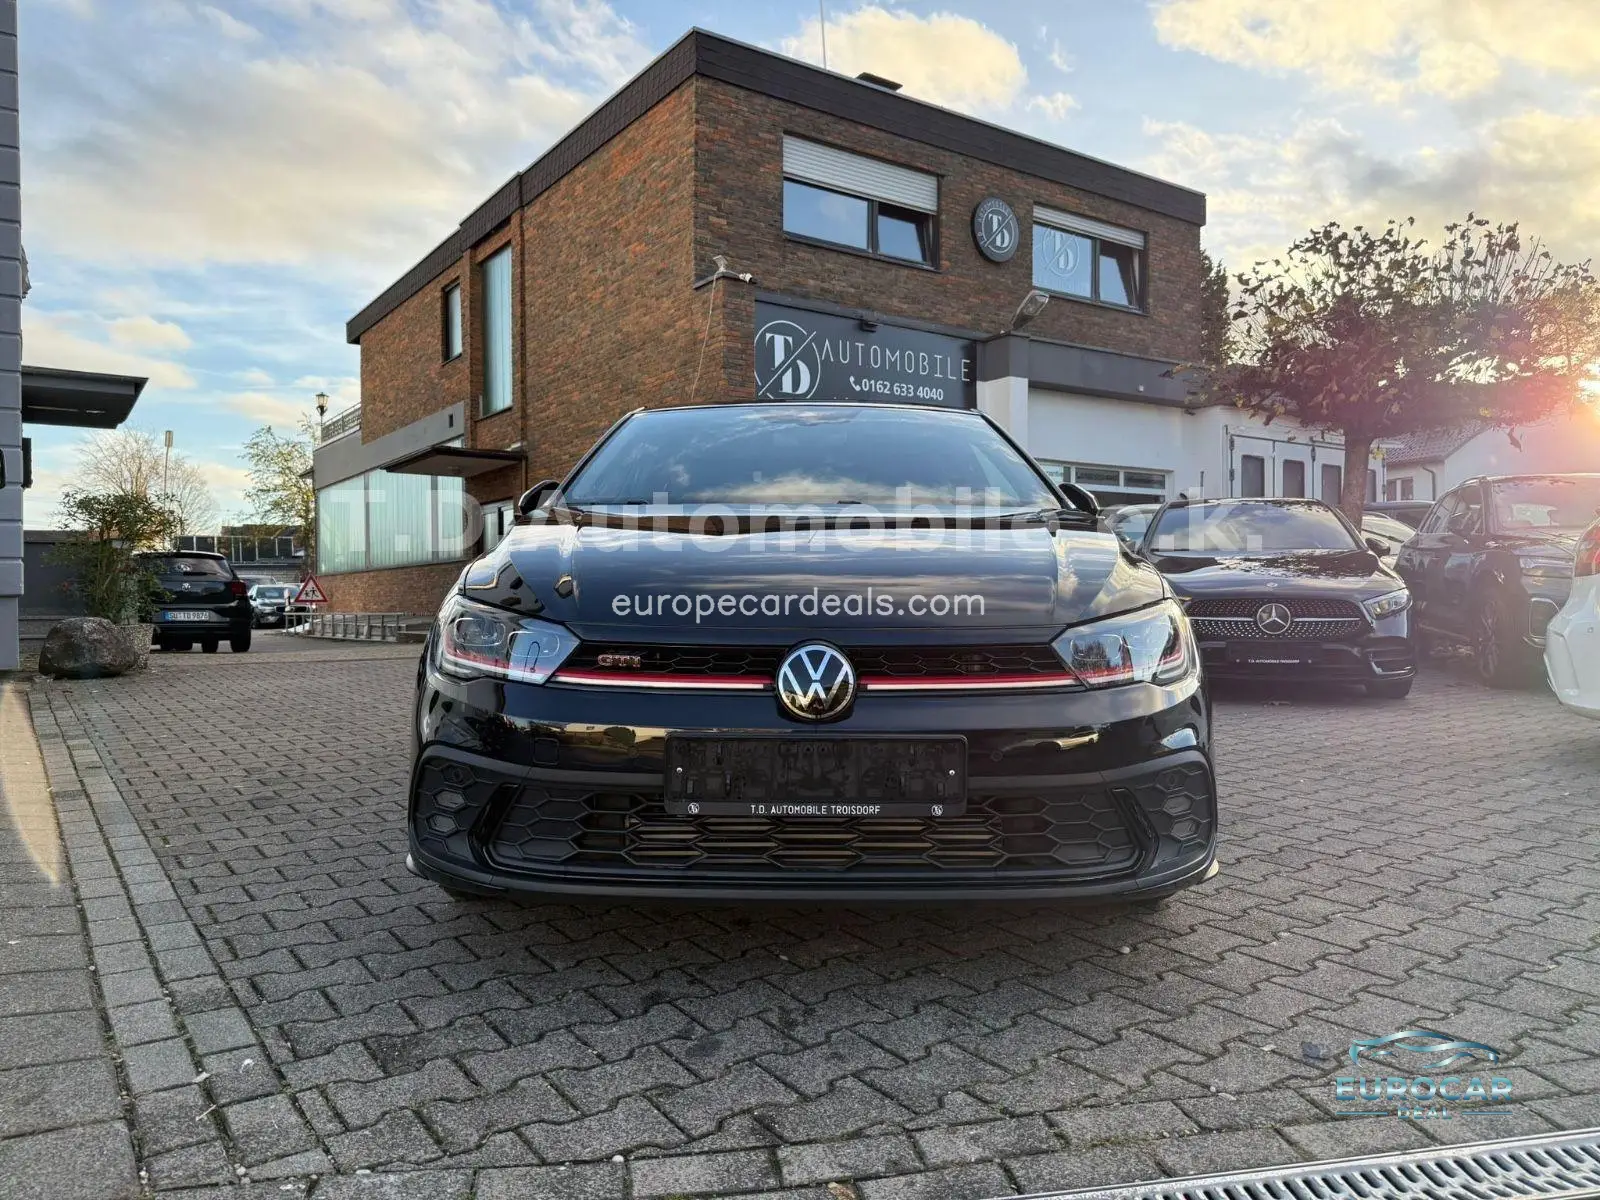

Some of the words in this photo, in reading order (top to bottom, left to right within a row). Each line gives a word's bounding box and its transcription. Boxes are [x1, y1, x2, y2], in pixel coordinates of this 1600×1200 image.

[821, 338, 971, 382] AUTOMOBILE
[861, 378, 891, 394] 0162
[893, 382, 914, 397] 633
[917, 386, 944, 401] 4040
[750, 804, 768, 815] T.D.
[770, 804, 828, 815] AUTOMOBILE
[830, 805, 881, 816] TROISDORF
